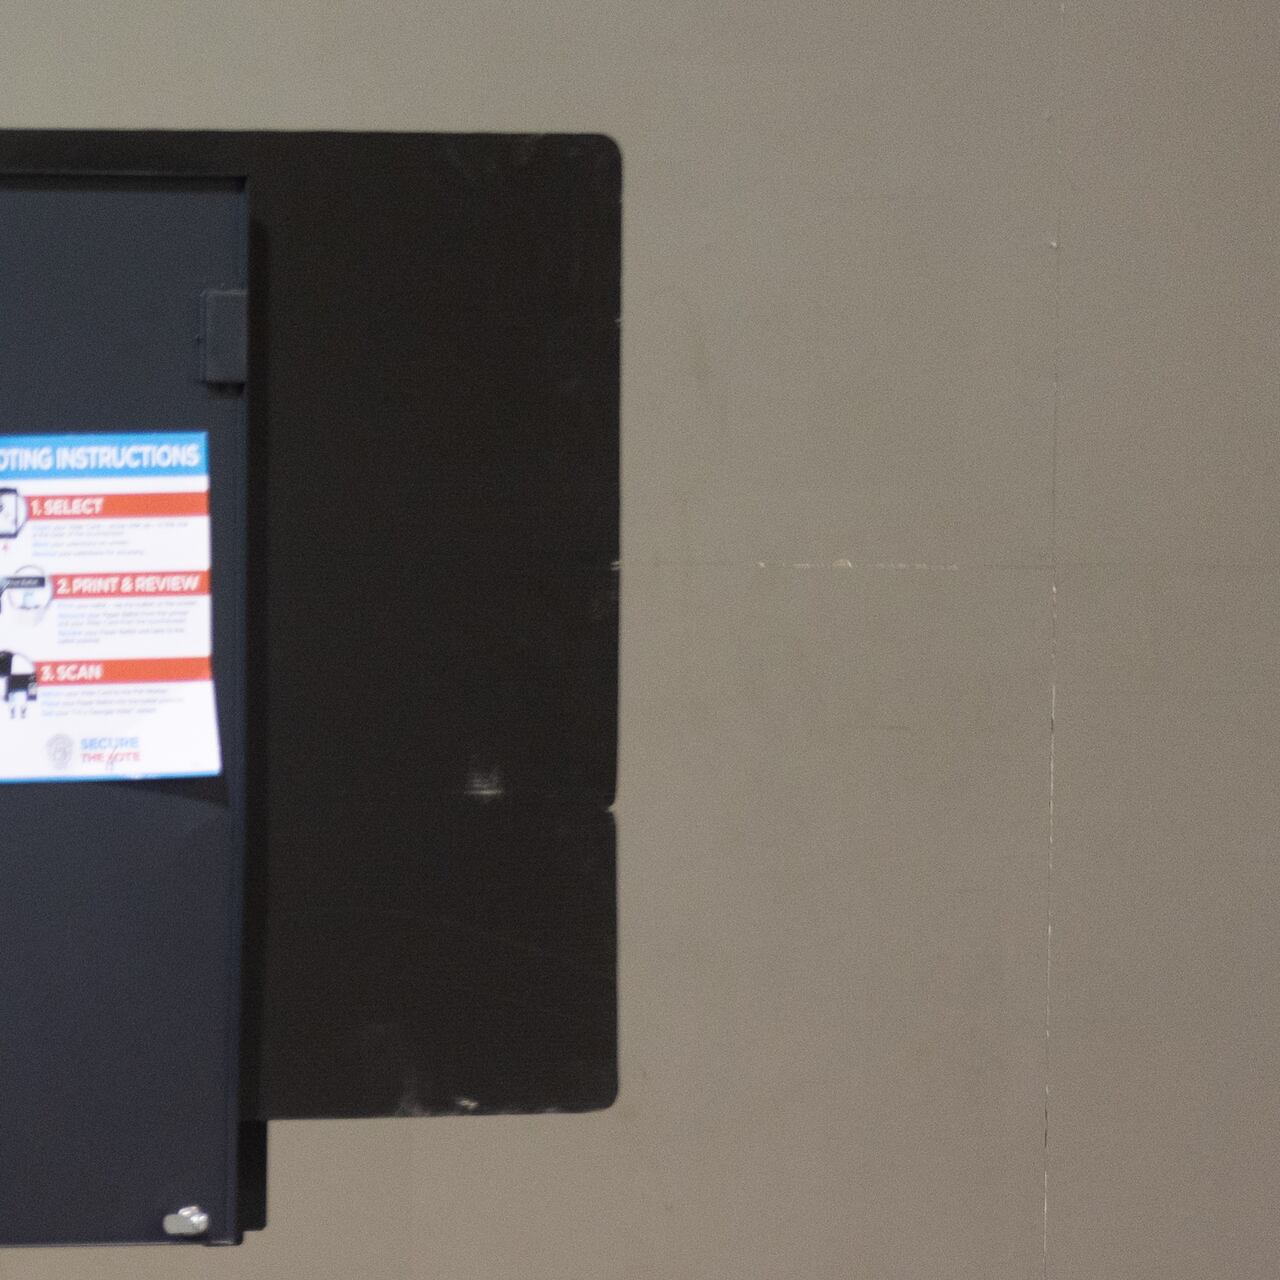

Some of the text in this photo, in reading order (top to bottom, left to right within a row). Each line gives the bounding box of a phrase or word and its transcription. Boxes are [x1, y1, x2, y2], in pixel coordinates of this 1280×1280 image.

[56, 443, 200, 469] INSTRUCTIONS
[31, 497, 104, 516] 1. SELECT
[56, 578, 70, 594] 2.
[72, 577, 117, 593] PRINT
[121, 576, 134, 593] &
[134, 575, 200, 592] REVIEW
[41, 664, 104, 682] 3. SCAN
[80, 737, 139, 749] SECURE
[81, 752, 105, 764] THE
